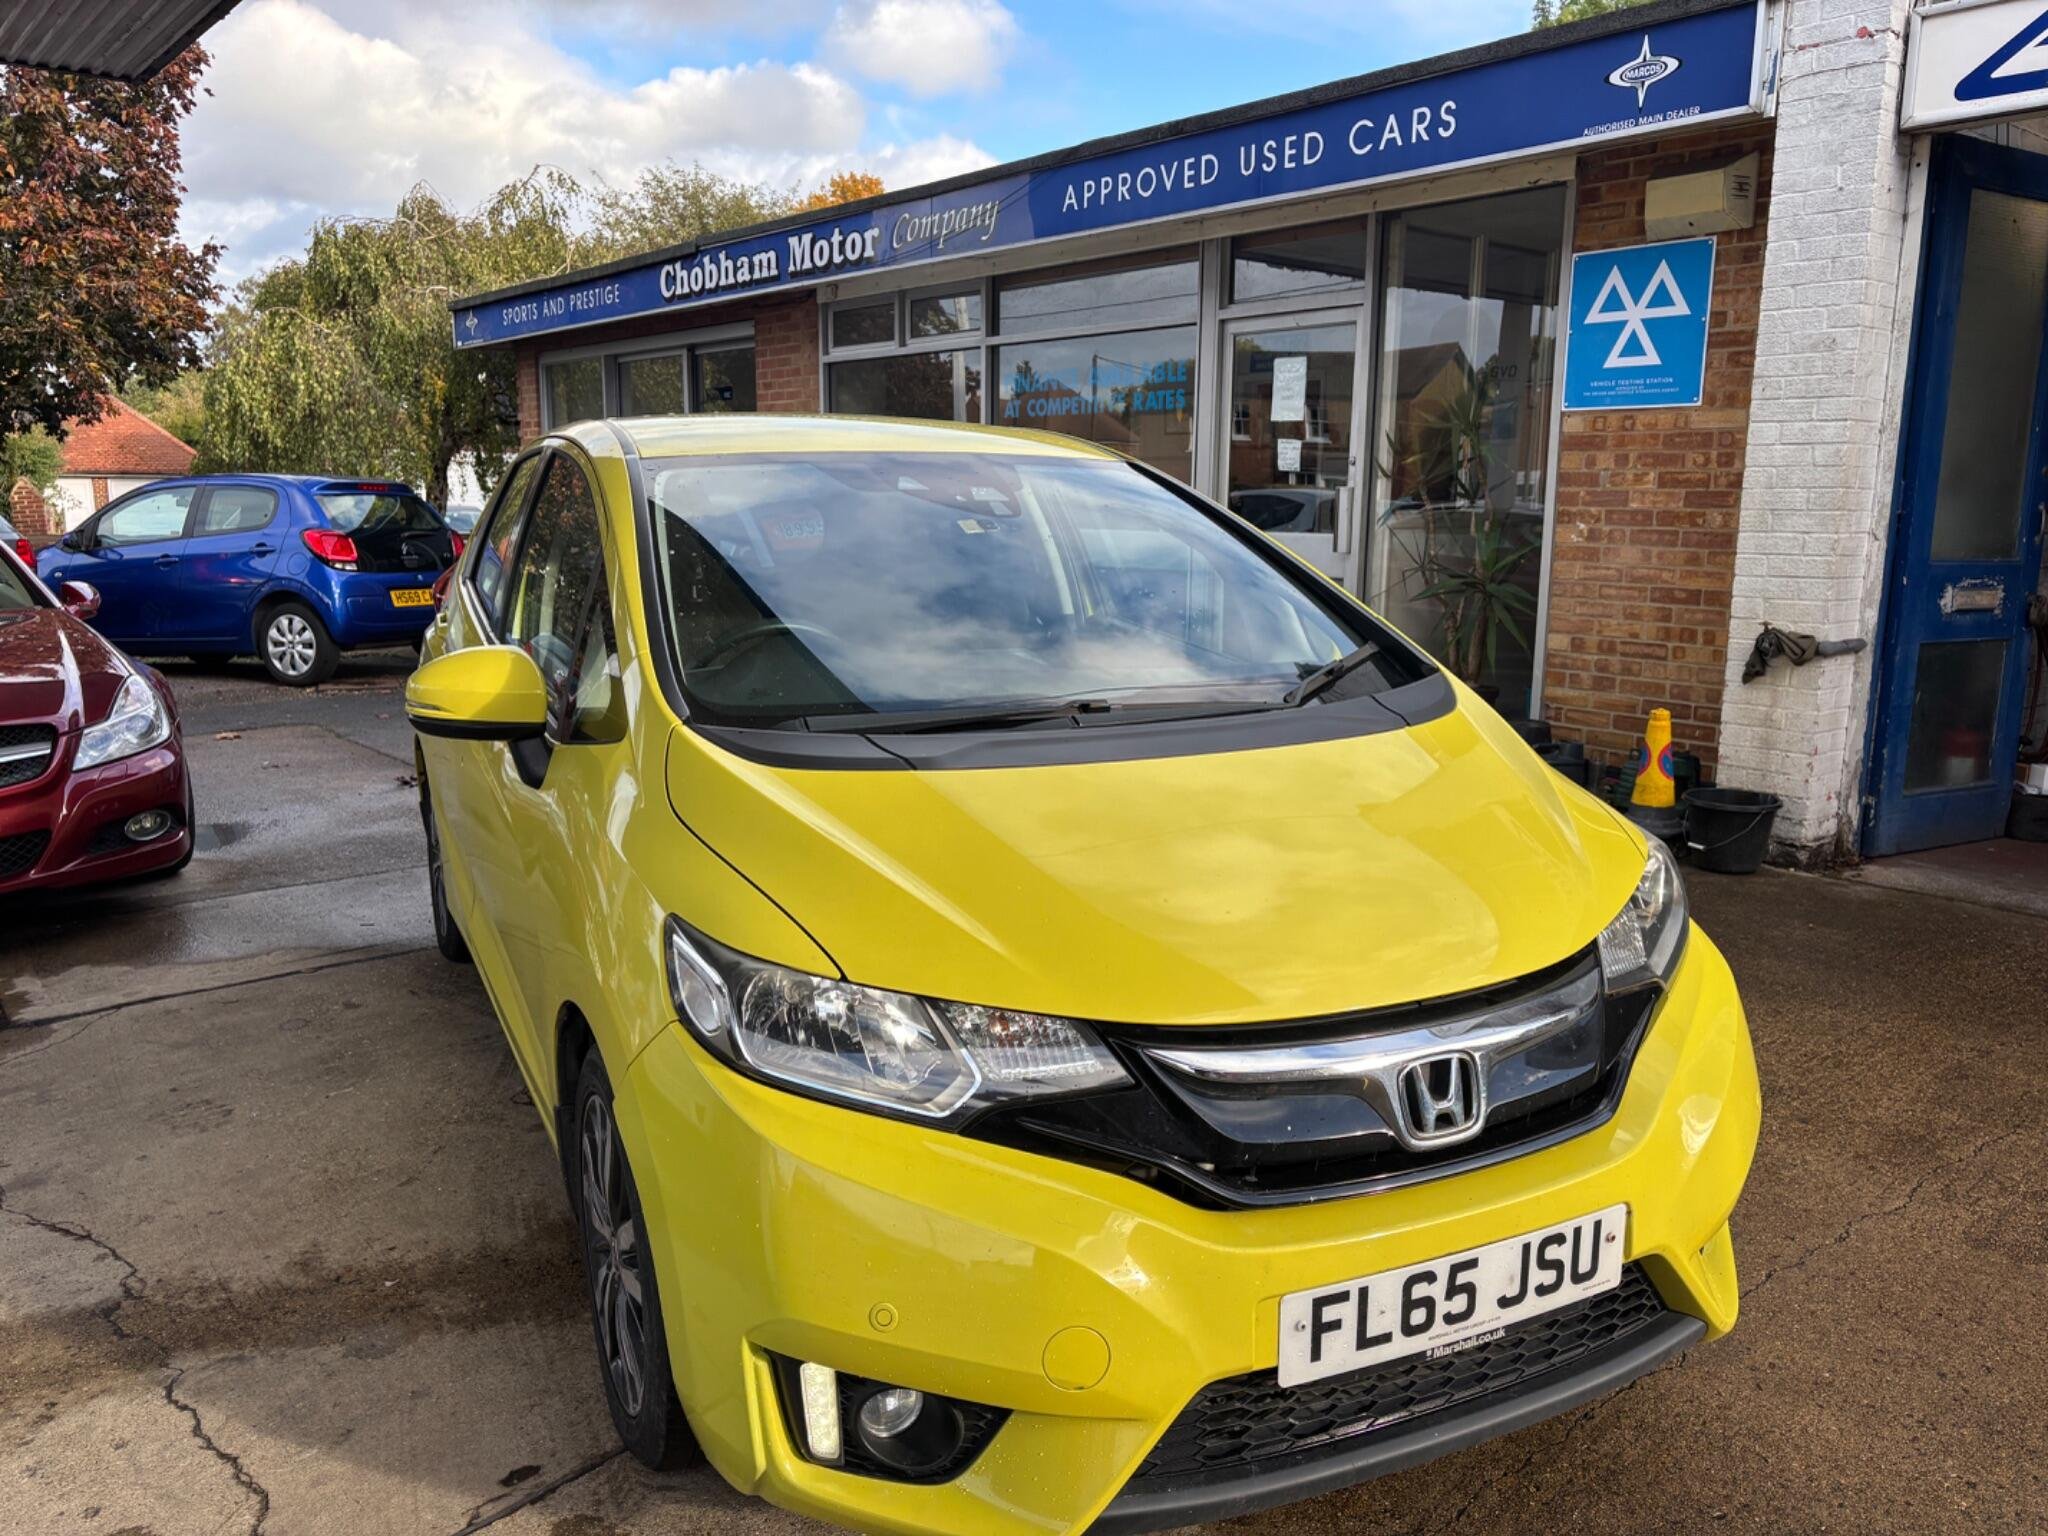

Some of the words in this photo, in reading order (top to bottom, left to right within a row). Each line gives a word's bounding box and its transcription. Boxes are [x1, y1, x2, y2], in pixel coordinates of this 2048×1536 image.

[1625, 63, 1661, 79] MARCOS
[1583, 118, 1636, 137] AUTHORISED
[1639, 113, 1663, 126] MAIN
[1666, 105, 1701, 120] DEALER
[1062, 153, 1219, 213] APPROVED
[1239, 131, 1325, 176] USED
[1349, 100, 1457, 156] CARS
[659, 249, 779, 299] Chobham
[788, 225, 880, 276] Motor
[892, 199, 1000, 249] Company
[502, 302, 539, 326] SPORTS
[543, 297, 565, 318] AND
[570, 284, 620, 311] PRESTIGE
[1004, 400, 1021, 419] AT
[1132, 388, 1186, 412] RATES
[1309, 1256, 1480, 1364] FL65
[1496, 1218, 1603, 1311] JSU
